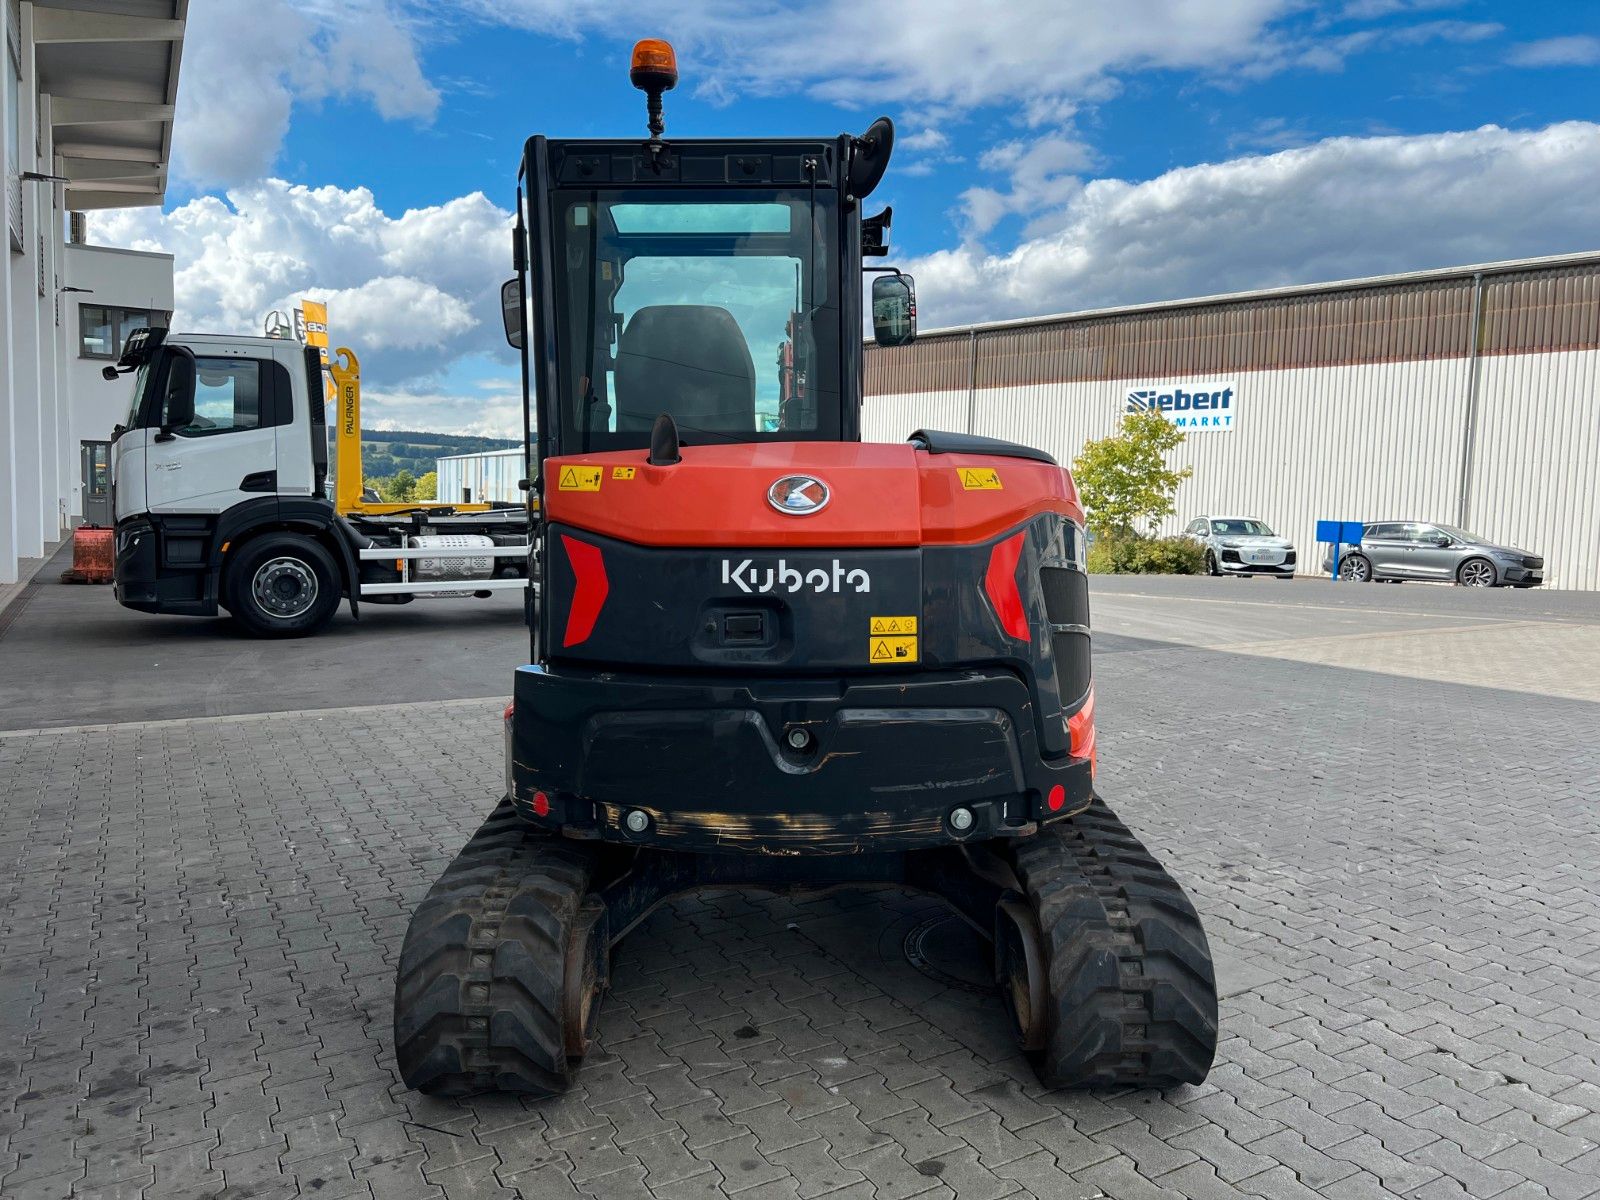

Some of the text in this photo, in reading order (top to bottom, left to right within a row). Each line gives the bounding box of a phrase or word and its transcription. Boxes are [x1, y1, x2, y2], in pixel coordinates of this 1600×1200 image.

[345, 386, 354, 435] PALFINGER
[1127, 386, 1234, 413] Siebert
[721, 559, 871, 593] Kubota
